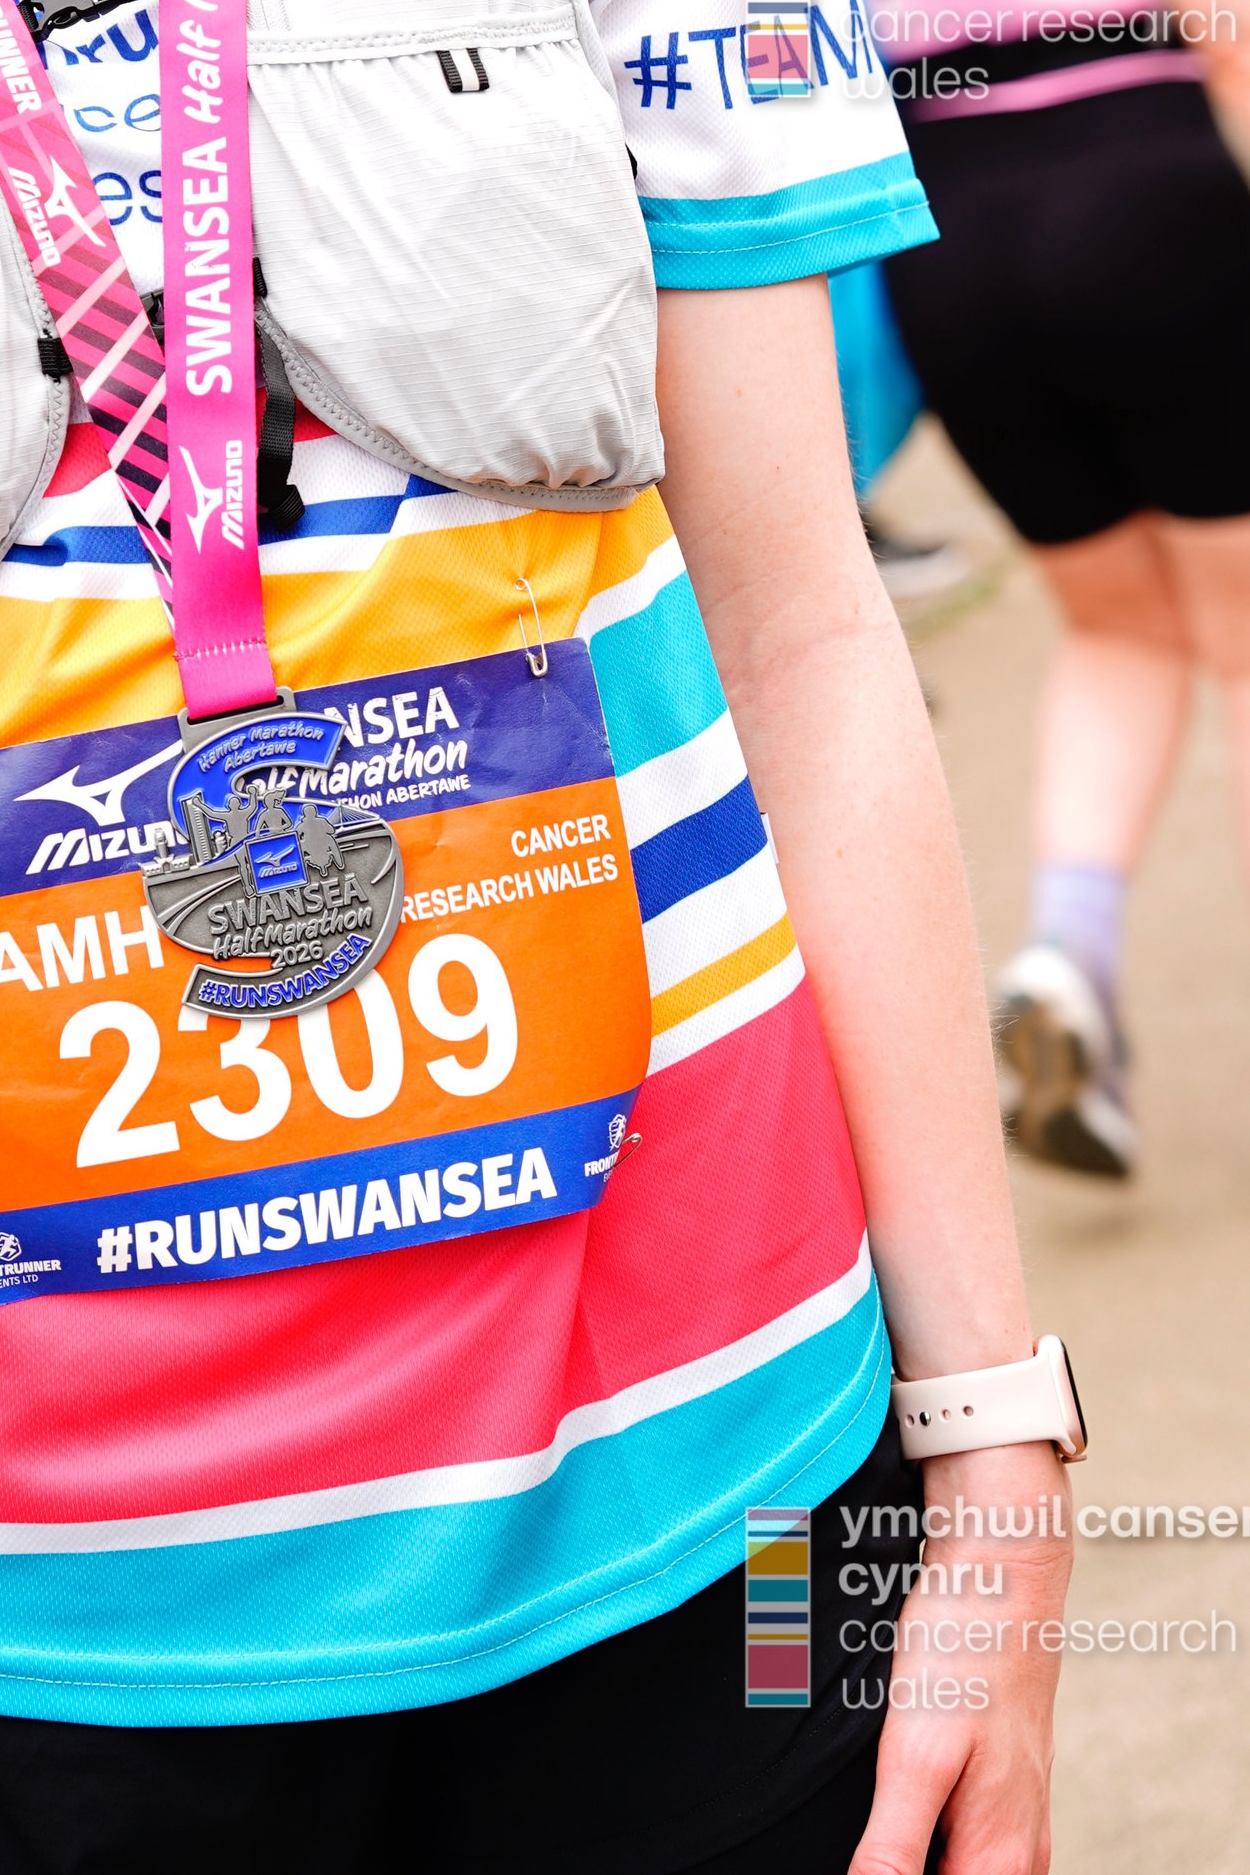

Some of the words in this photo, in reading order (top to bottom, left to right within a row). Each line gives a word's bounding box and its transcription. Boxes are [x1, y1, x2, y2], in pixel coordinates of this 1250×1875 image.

[176, 19, 224, 124] Half
[181, 136, 232, 396] SWANSEA
[250, 719, 325, 745] Marathon
[324, 686, 460, 750] NSEA
[223, 739, 296, 773] Abertawe
[386, 774, 472, 805] ABERTAWE
[511, 814, 611, 858] CANCER
[207, 874, 369, 936] SWANSEA
[400, 870, 534, 924] RESEARCH
[535, 853, 619, 895] WALES
[198, 933, 373, 1008] #RUNSWANSEA
[271, 940, 325, 970] 2026
[58, 933, 519, 1168] 2309
[96, 1147, 558, 1274] #RUNSWANSEA
[23, 1274, 39, 1284] LTD
